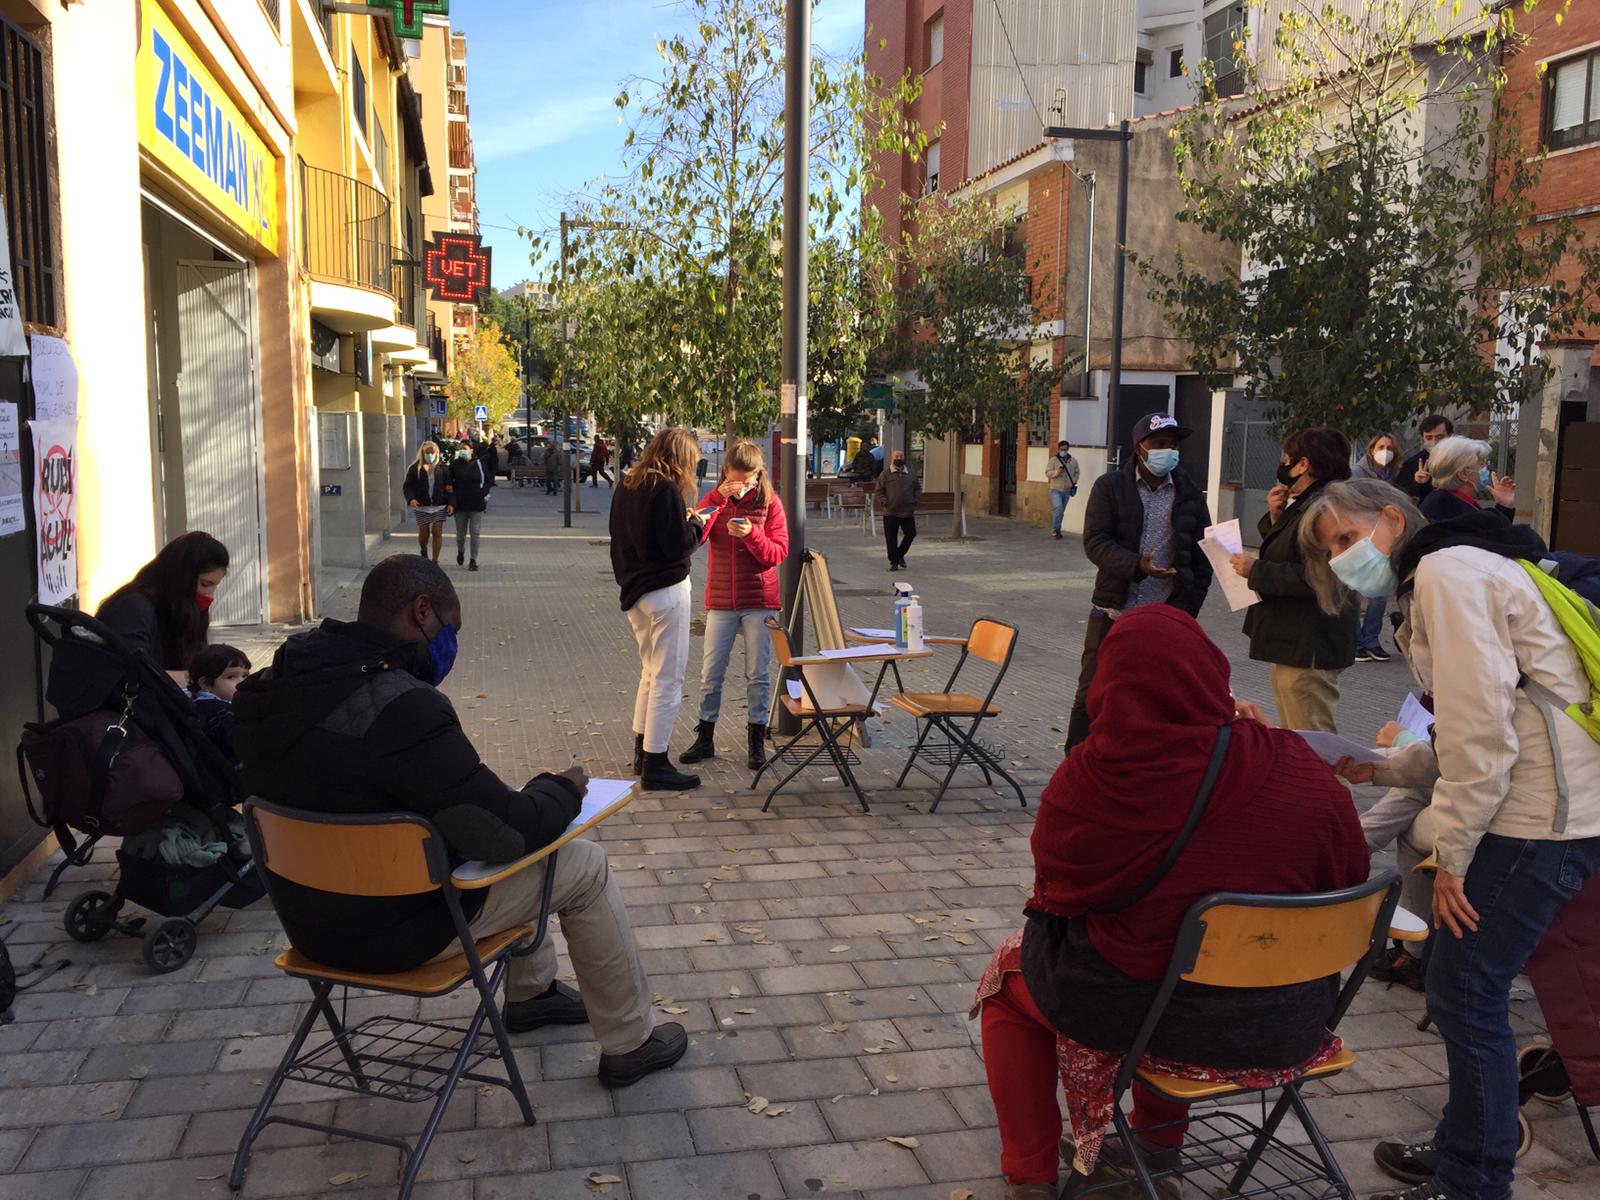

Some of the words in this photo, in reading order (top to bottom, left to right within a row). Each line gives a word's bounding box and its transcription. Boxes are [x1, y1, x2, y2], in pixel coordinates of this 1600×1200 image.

[152, 27, 249, 212] ZEEMAN
[251, 149, 268, 229] XL
[441, 259, 477, 277] VET
